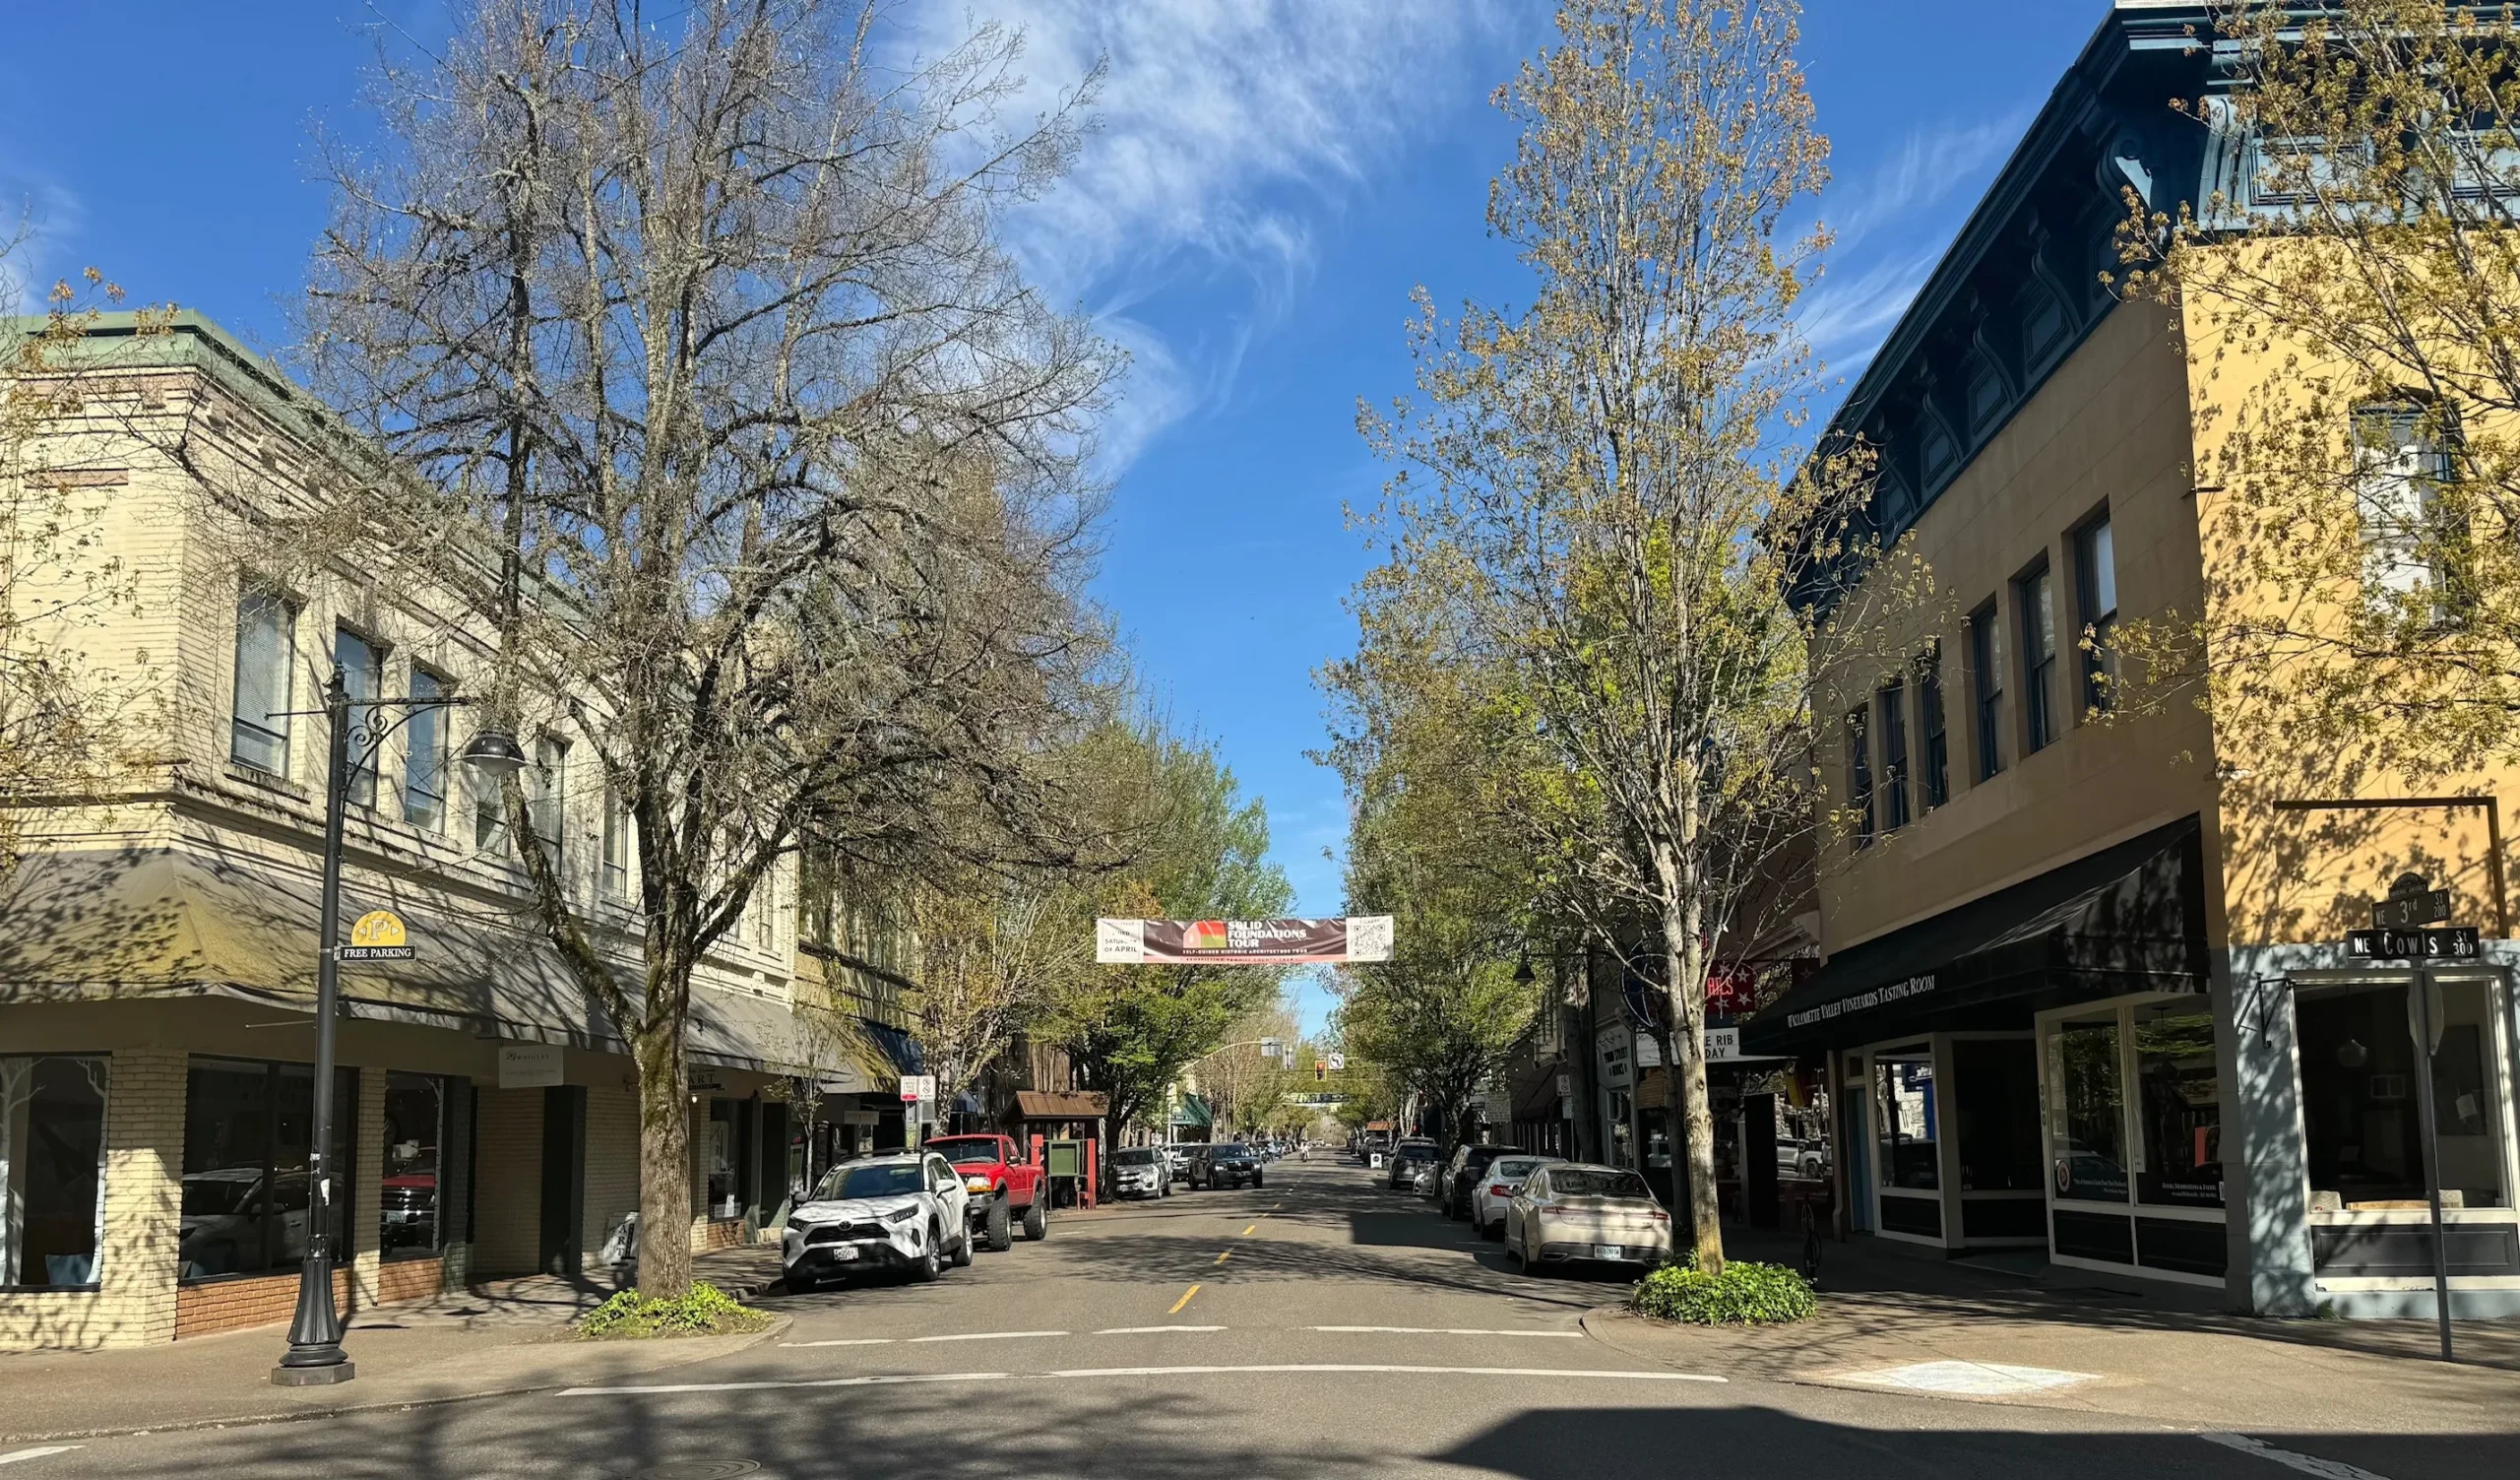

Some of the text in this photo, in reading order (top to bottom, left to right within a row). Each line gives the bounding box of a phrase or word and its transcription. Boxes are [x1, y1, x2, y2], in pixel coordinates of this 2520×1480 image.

[2375, 892, 2443, 926] NE 3rd St
[2433, 905, 2447, 919] 200
[368, 919, 390, 940] P
[1228, 921, 1263, 931] SOLID
[1228, 930, 1307, 939] FOUNDATIONS
[1228, 938, 1260, 948] TOUR
[2354, 936, 2370, 953] NE
[2455, 930, 2468, 943] St
[344, 947, 411, 958] FREE PARKING
[2452, 942, 2474, 955] 300
[1820, 1001, 1842, 1019] VALLEY
[1842, 991, 1878, 1013] VINEYARDS
[1878, 981, 1910, 1004] TASTING
[1909, 974, 1935, 995] ROOM
[1716, 1034, 1734, 1046] RIB
[688, 1073, 717, 1084] ART
